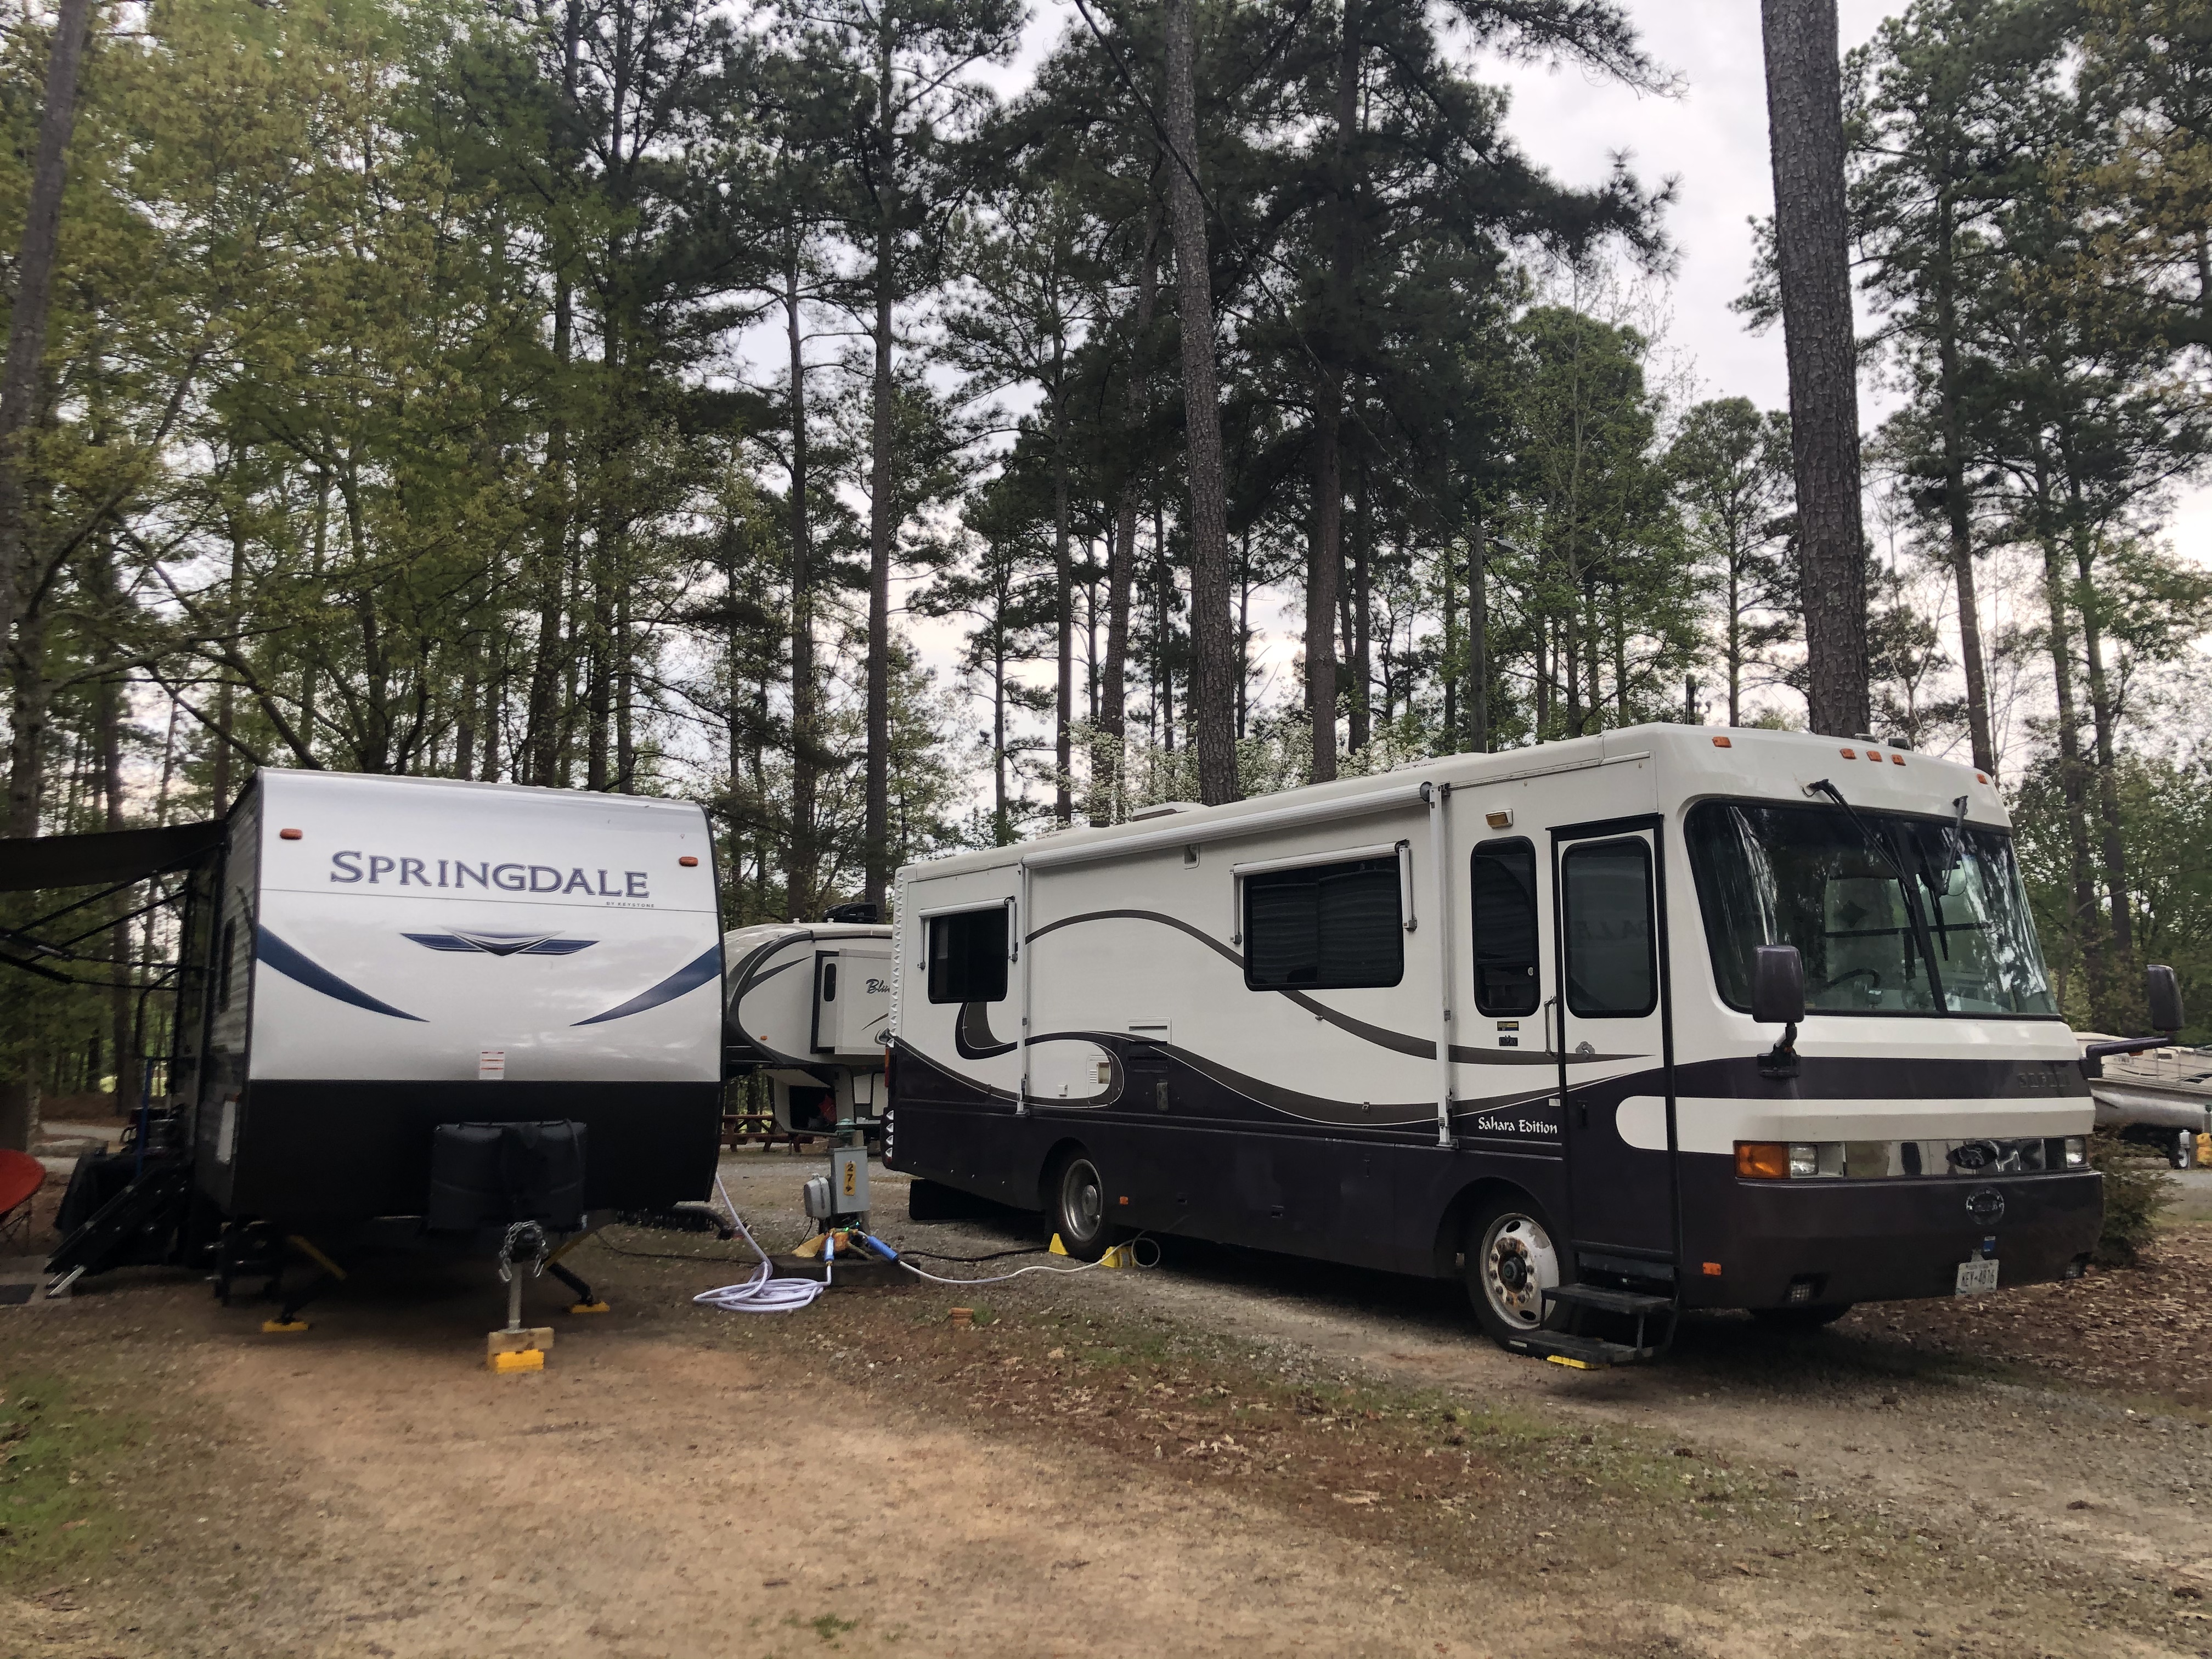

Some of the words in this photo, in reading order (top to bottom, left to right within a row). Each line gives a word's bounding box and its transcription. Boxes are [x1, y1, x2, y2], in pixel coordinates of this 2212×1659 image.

[330, 850, 650, 898] SPRINGDALE
[1478, 1116, 1515, 1131] Sahara
[1519, 1119, 1558, 1134] Edition
